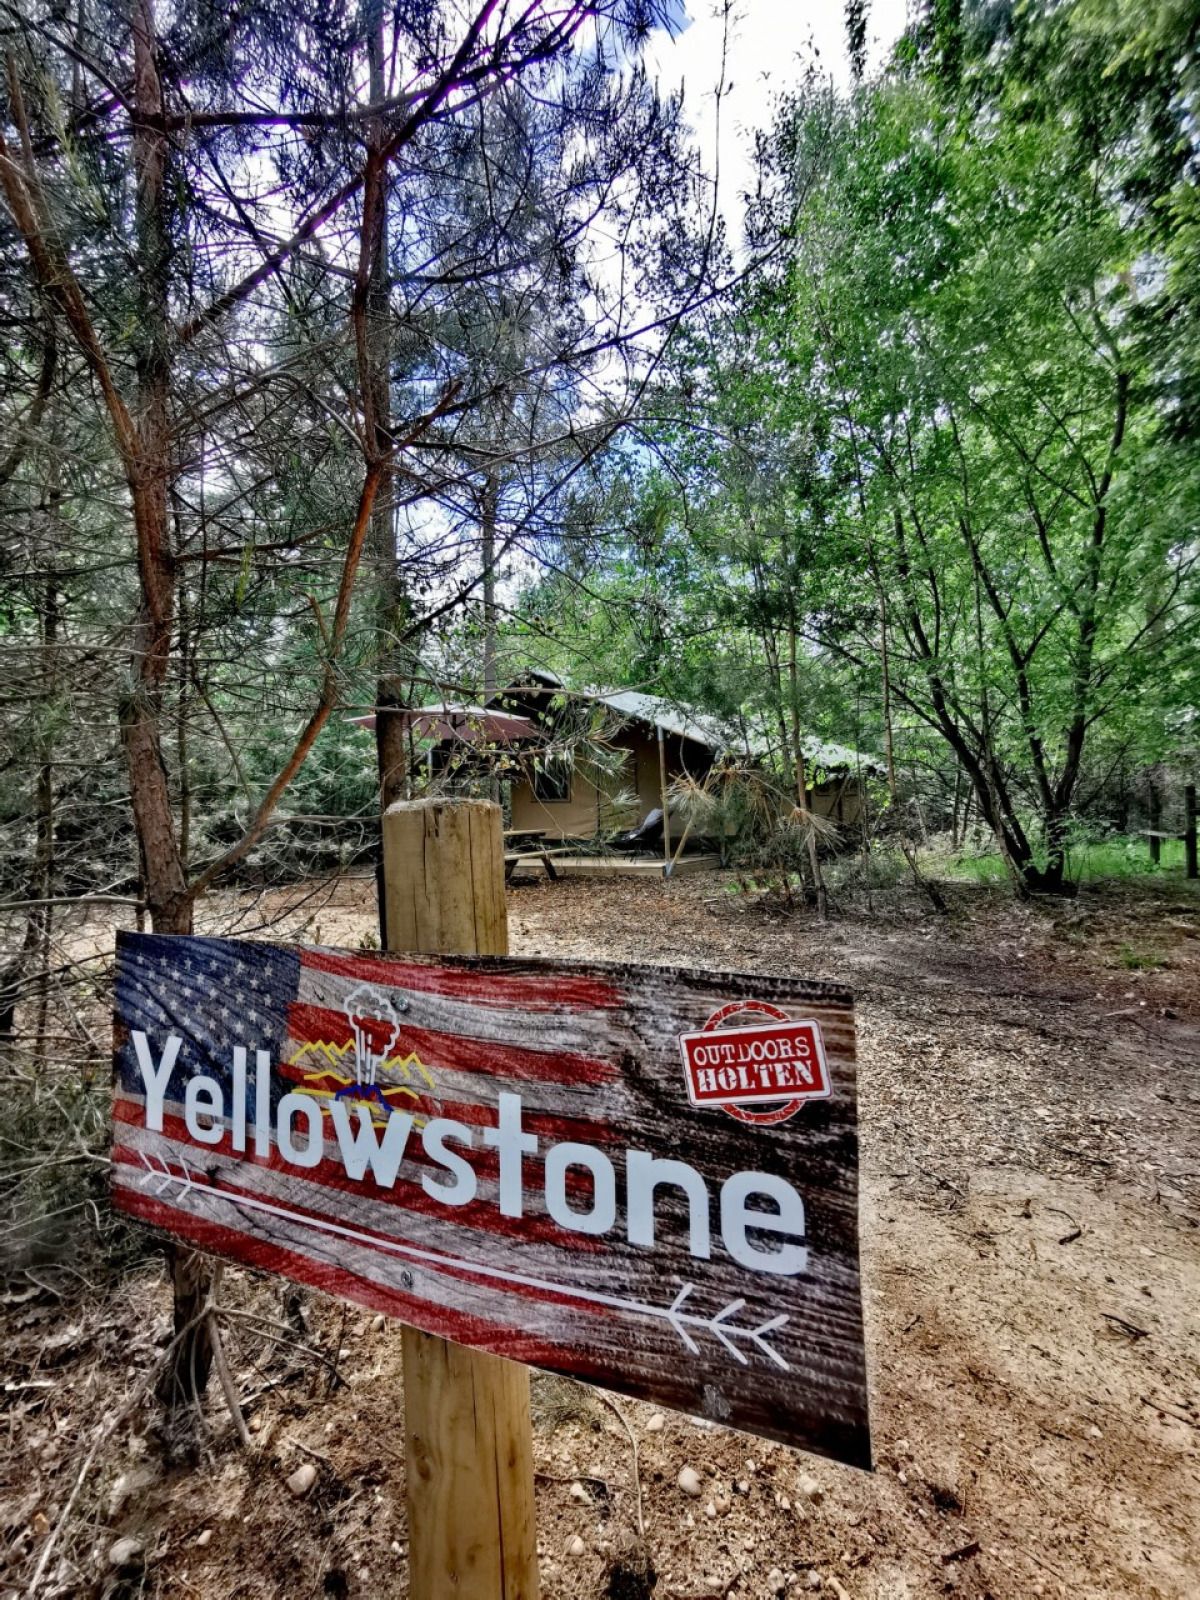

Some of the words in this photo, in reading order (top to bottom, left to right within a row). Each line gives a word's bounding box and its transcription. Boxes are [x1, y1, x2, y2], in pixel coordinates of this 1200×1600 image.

[693, 1036, 811, 1066] OUTDOORS
[696, 1060, 815, 1092] HOLTEN
[131, 1029, 809, 1276] Yellowstone
